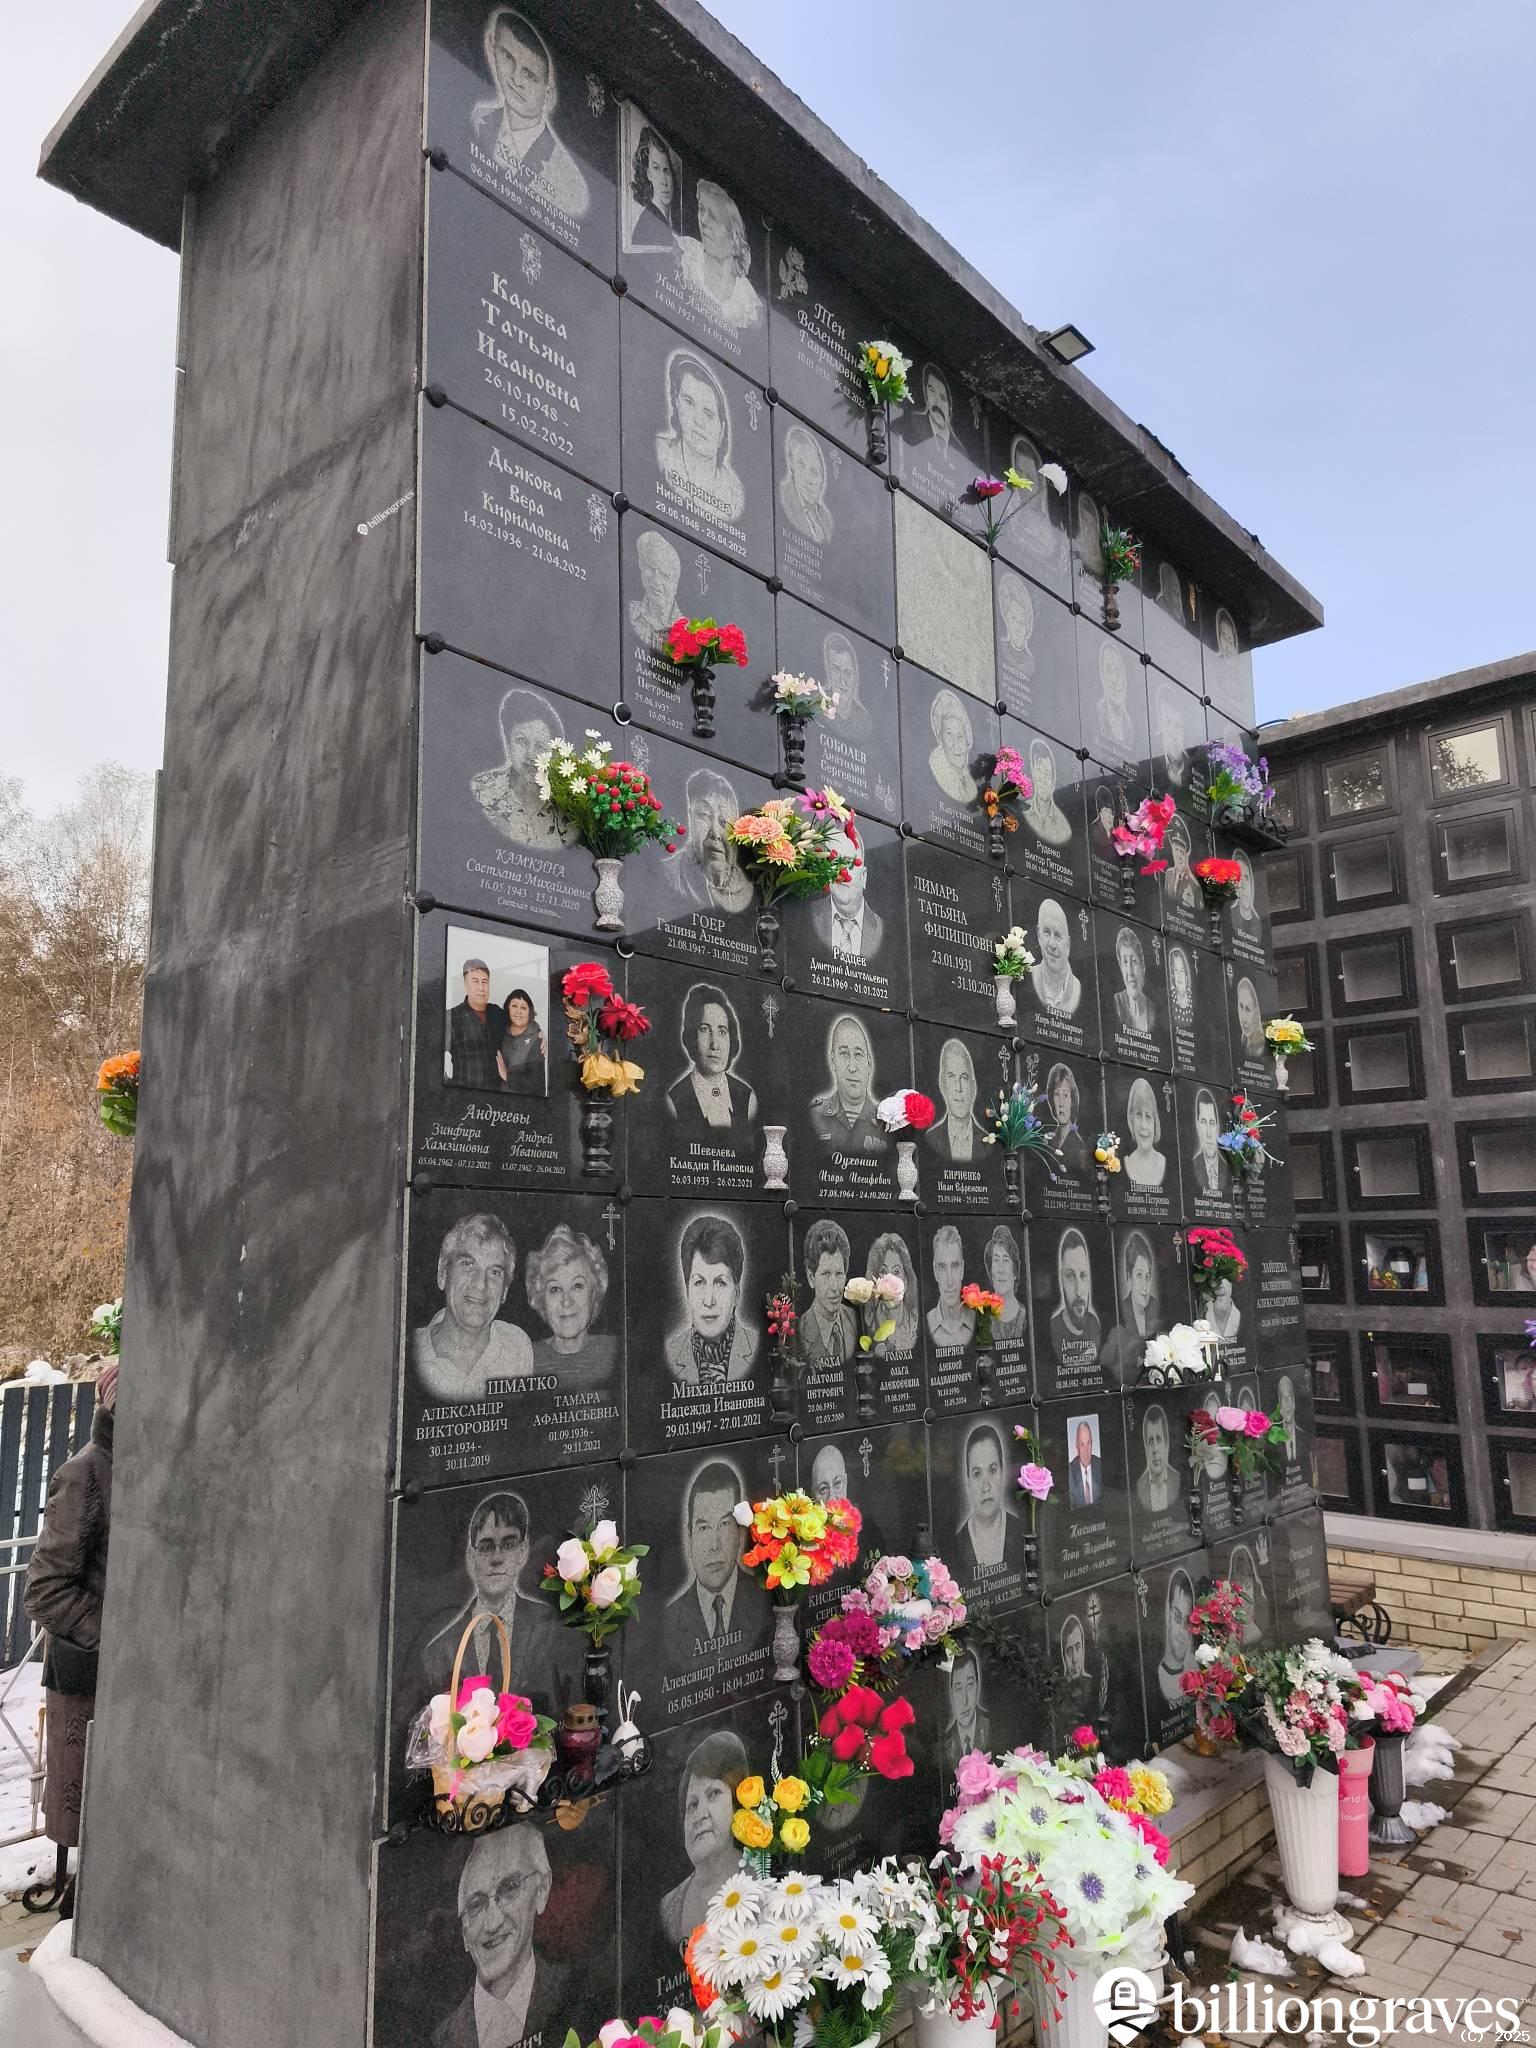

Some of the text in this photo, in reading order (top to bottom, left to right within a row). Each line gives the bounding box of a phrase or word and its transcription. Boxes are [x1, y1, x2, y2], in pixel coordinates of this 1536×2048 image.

[470, 142, 581, 232] Иван Александрович
[471, 163, 579, 247] 06.04.1989 09.04.2022
[491, 272, 568, 340] Карева
[814, 303, 846, 340] Тен
[481, 299, 576, 378] Татьяна
[798, 310, 859, 368] Валентин
[476, 329, 581, 412] Ивановна
[800, 329, 862, 388] Гавриловна
[484, 368, 558, 421] 26.10.1948
[500, 404, 574, 456] 15.02.2022
[488, 446, 563, 501] Дьякова
[510, 484, 545, 517] Вера
[672, 471, 731, 514] Зырянова
[481, 491, 569, 552] Кирилловна
[656, 481, 746, 542] Нина Николаевна
[464, 511, 587, 581] 14.02.1936 21.04.2022
[638, 677, 681, 704] Петрович
[820, 733, 867, 765] СОБОЛЕВ
[820, 759, 867, 789] Сергеевич
[822, 748, 865, 776] Анатолий
[496, 849, 566, 878] КАМКИНА
[466, 858, 591, 900] Светлана Михайловна
[913, 875, 959, 902] ЛИМАРЬ
[480, 879, 579, 911] 16.05.1943 15.11.2020
[691, 913, 726, 933] ГОЕР
[918, 898, 968, 925] ТАТЬЯНА
[656, 917, 758, 955] Галина Алексеевна
[924, 922, 996, 954] ФИЛИППОВН
[667, 938, 749, 965] 21.08.1947 31.01.2022
[833, 946, 867, 967] Радцев
[931, 950, 972, 972] 23.01.1931
[810, 958, 889, 985] Дмитрий Анатольевич
[812, 974, 888, 999] 26.12.1969 01.01.2022
[461, 1104, 530, 1126] Андреевы
[432, 1122, 482, 1140] Зинфира
[515, 1131, 553, 1147] Андрей
[421, 1137, 490, 1154] Хамзиновна
[510, 1145, 559, 1159] Иванович
[689, 1143, 736, 1158] Шевелева
[458, 1160, 491, 1170] 07.12.2021
[669, 1157, 754, 1173] Клавдия Ивановна
[832, 1151, 878, 1170] Духонин
[717, 1178, 753, 1188] 26.02.2021
[819, 1170, 891, 1186] Игорь Иосифович
[938, 1181, 954, 1191] Иван
[487, 1375, 558, 1396] ШМАТКО
[672, 1379, 755, 1400] Михайленко
[807, 1372, 844, 1385] АНАТОЛИЙ
[554, 1392, 600, 1408] ТАМАРА
[807, 1386, 844, 1400] ПЕТРОВИЧ
[421, 1402, 504, 1422] АЛЕКСАНДР
[533, 1406, 620, 1427] АФАНАСЬЕВНА
[660, 1396, 765, 1420] Надежда Ивановна
[416, 1418, 508, 1441] ВИКТОРОВИЧ
[548, 1429, 589, 1442] 01.09.1936
[665, 1414, 761, 1438] 29.03.1947 27.01.2021
[429, 1441, 475, 1458] 30.12.1934
[562, 1440, 601, 1455] 29.11.2021
[445, 1455, 490, 1471] 30.11.2019
[973, 1562, 1008, 1581] Шахова
[983, 1573, 1021, 1594] Романовна
[808, 1585, 851, 1608] КИСЕЛЕВ
[692, 1630, 742, 1657] Агарин
[661, 1646, 770, 1694] Александр Евгеньевич
[668, 1668, 764, 1714] 05.05.1950 18.04.2022
